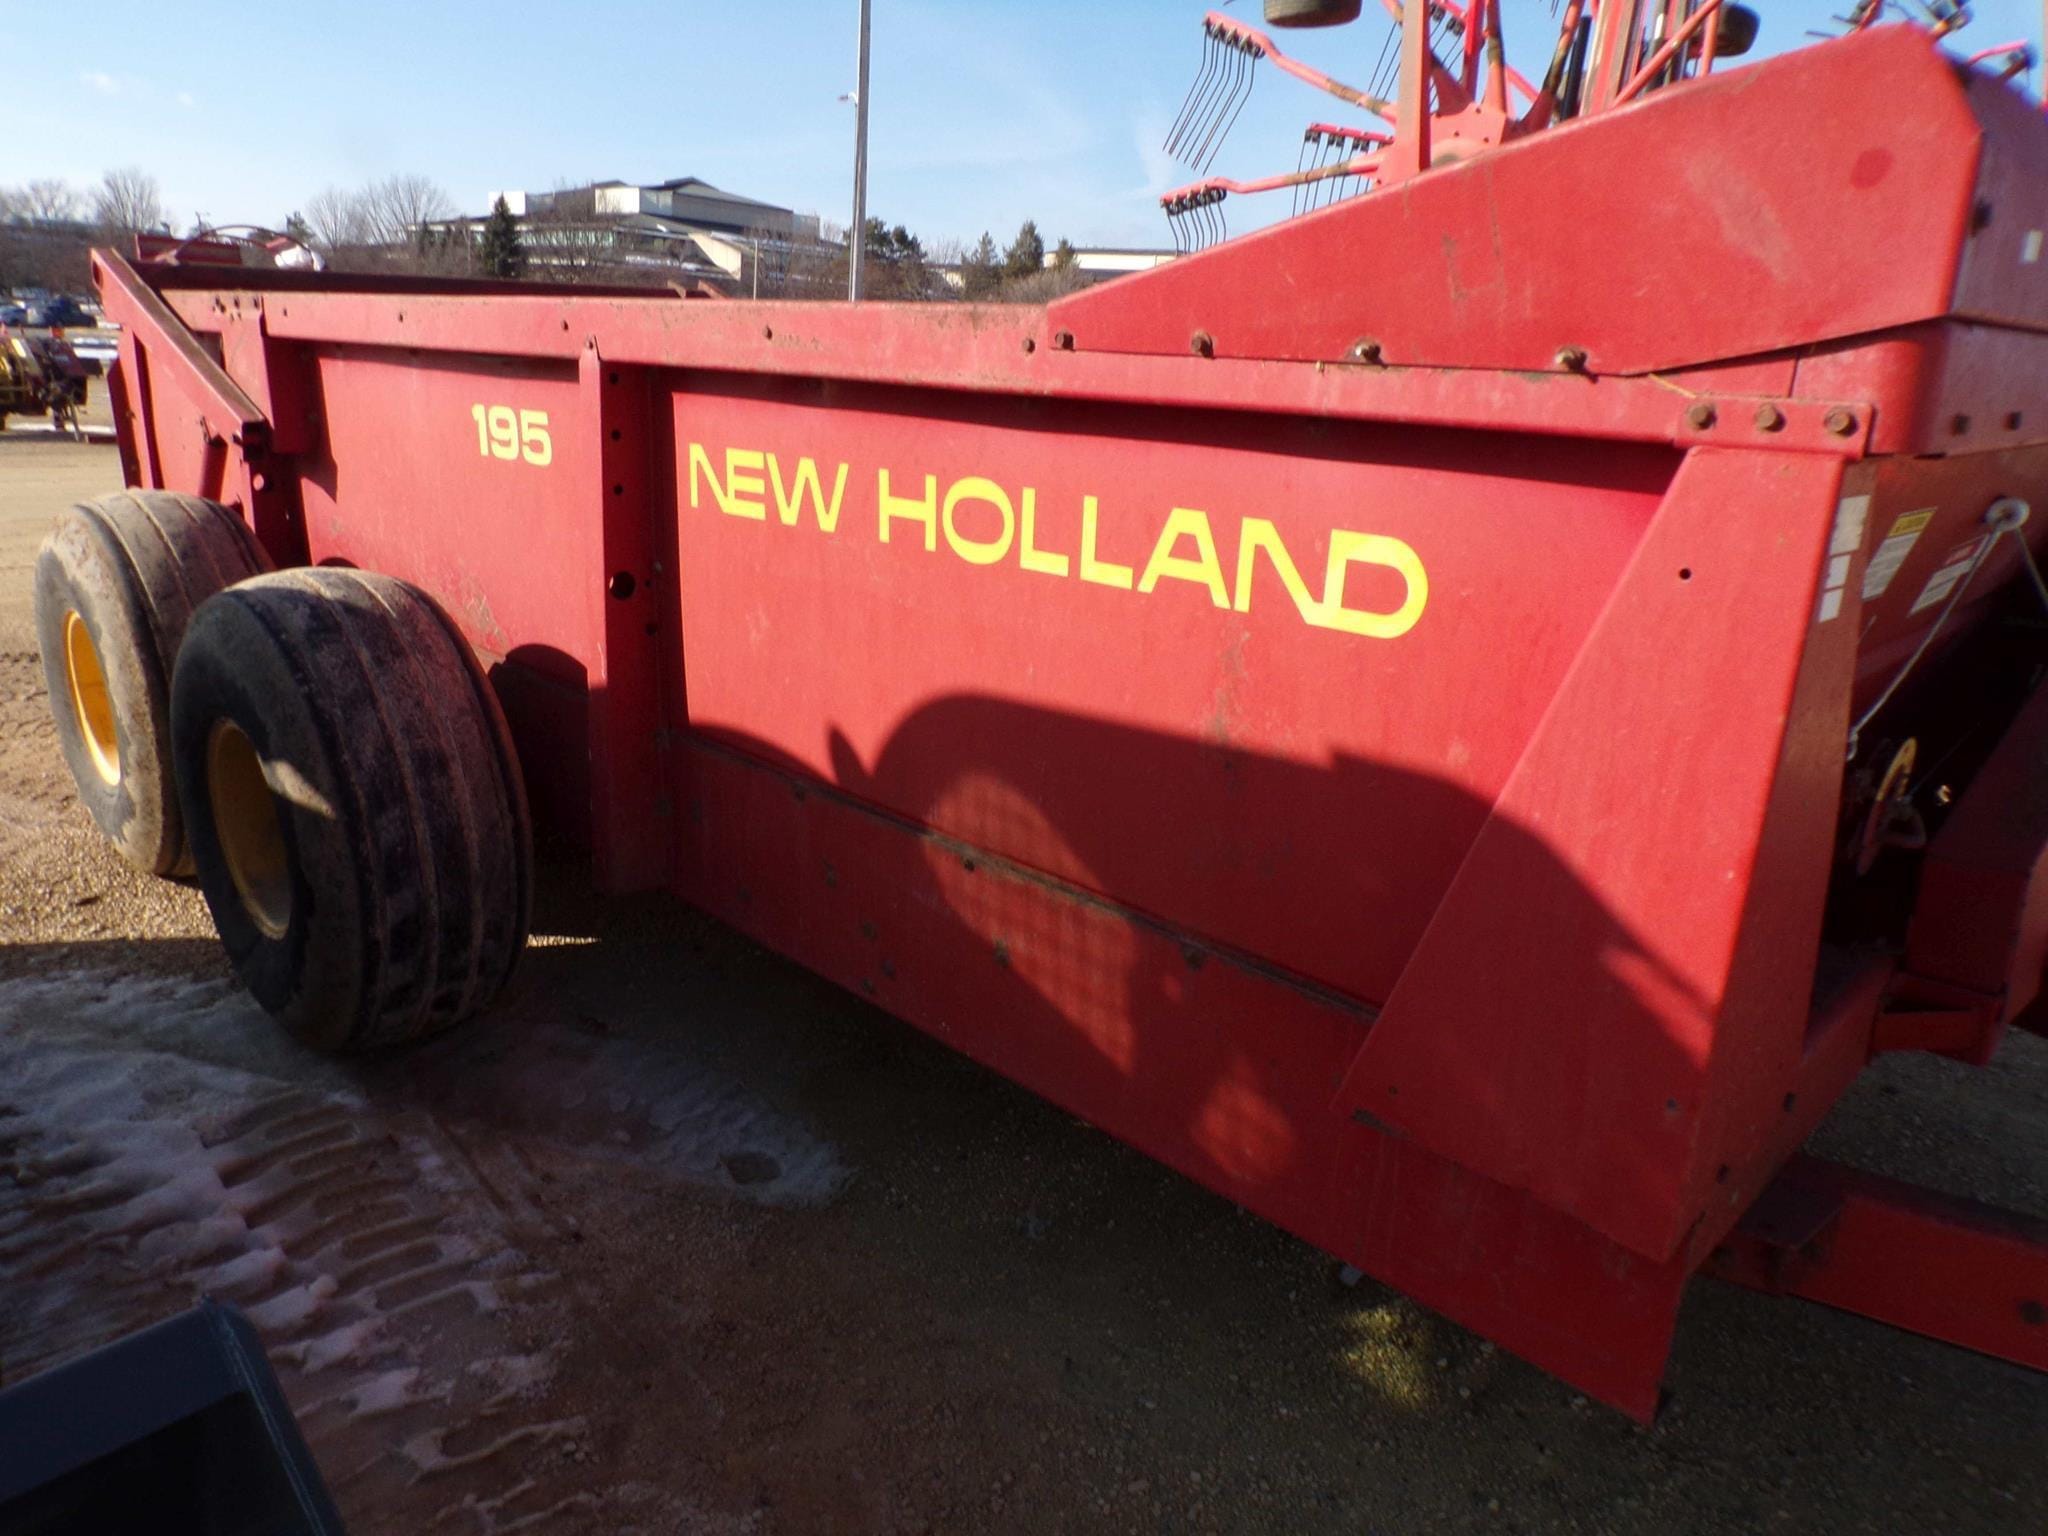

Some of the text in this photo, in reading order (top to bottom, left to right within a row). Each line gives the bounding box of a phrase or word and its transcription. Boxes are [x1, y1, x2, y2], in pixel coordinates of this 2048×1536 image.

[471, 404, 553, 467] 195
[689, 443, 1428, 638] NEW HOLLAND
